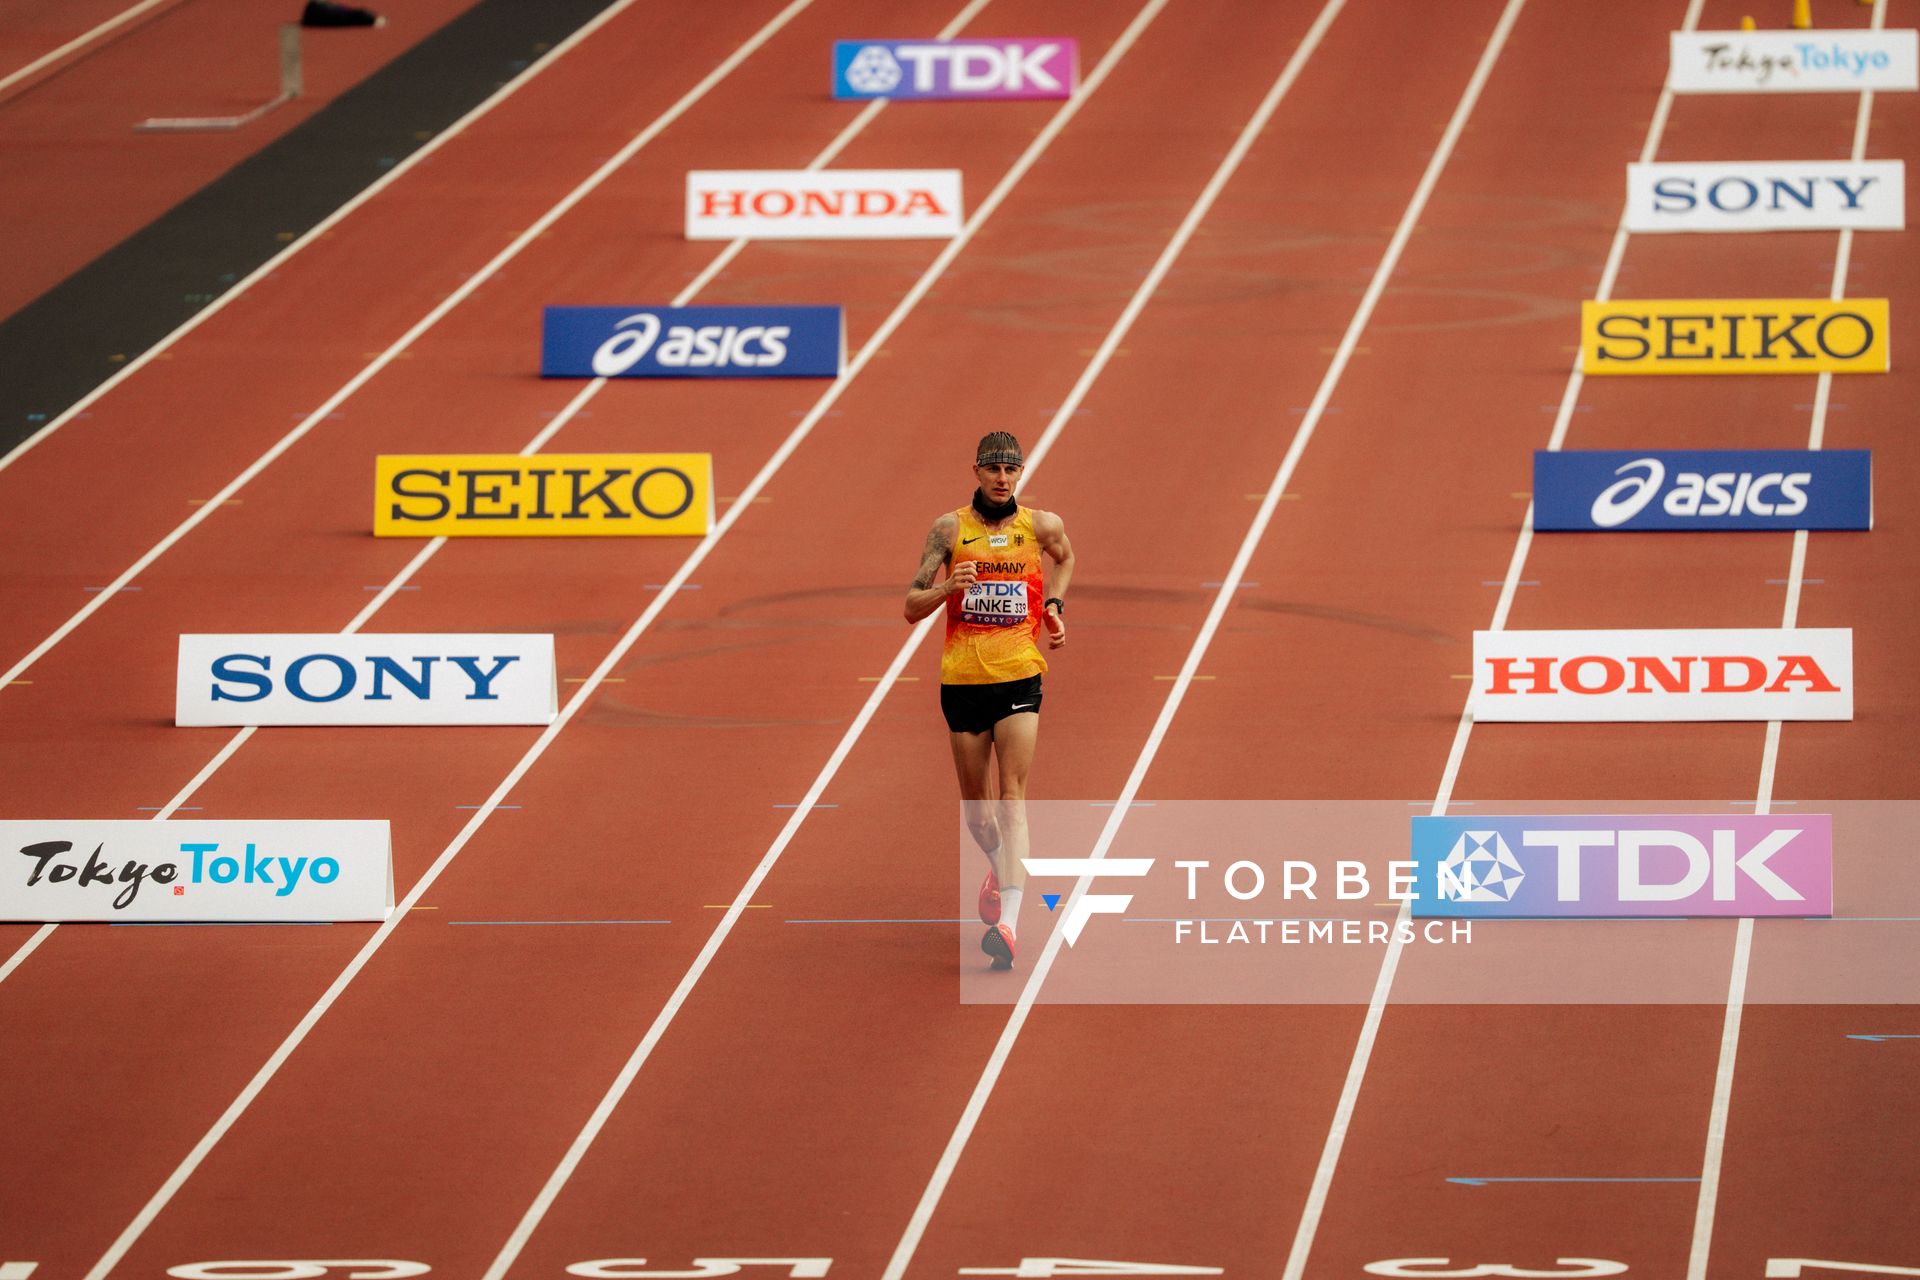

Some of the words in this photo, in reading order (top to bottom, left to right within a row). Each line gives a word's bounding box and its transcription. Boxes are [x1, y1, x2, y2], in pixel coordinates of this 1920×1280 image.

[896, 43, 1060, 92] TDK
[1702, 43, 1793, 83] Tokyo
[1794, 43, 1890, 77] Tokyo
[701, 190, 944, 216] HONDA
[1653, 178, 1880, 211] SONY
[656, 324, 789, 368] asics
[1596, 313, 1875, 361] SEIKO
[390, 468, 694, 521] SEIKO
[1662, 471, 1812, 517] asics
[975, 562, 1026, 574] ERMANY
[982, 583, 1022, 596] TDK
[966, 598, 1011, 612] LINKE
[1015, 603, 1026, 613] 339
[210, 653, 521, 703] SONY
[1485, 655, 1841, 695] HONDA
[19, 841, 179, 910] Tokyo
[180, 843, 340, 897] Tokyo
[1522, 829, 1806, 902] TDK
